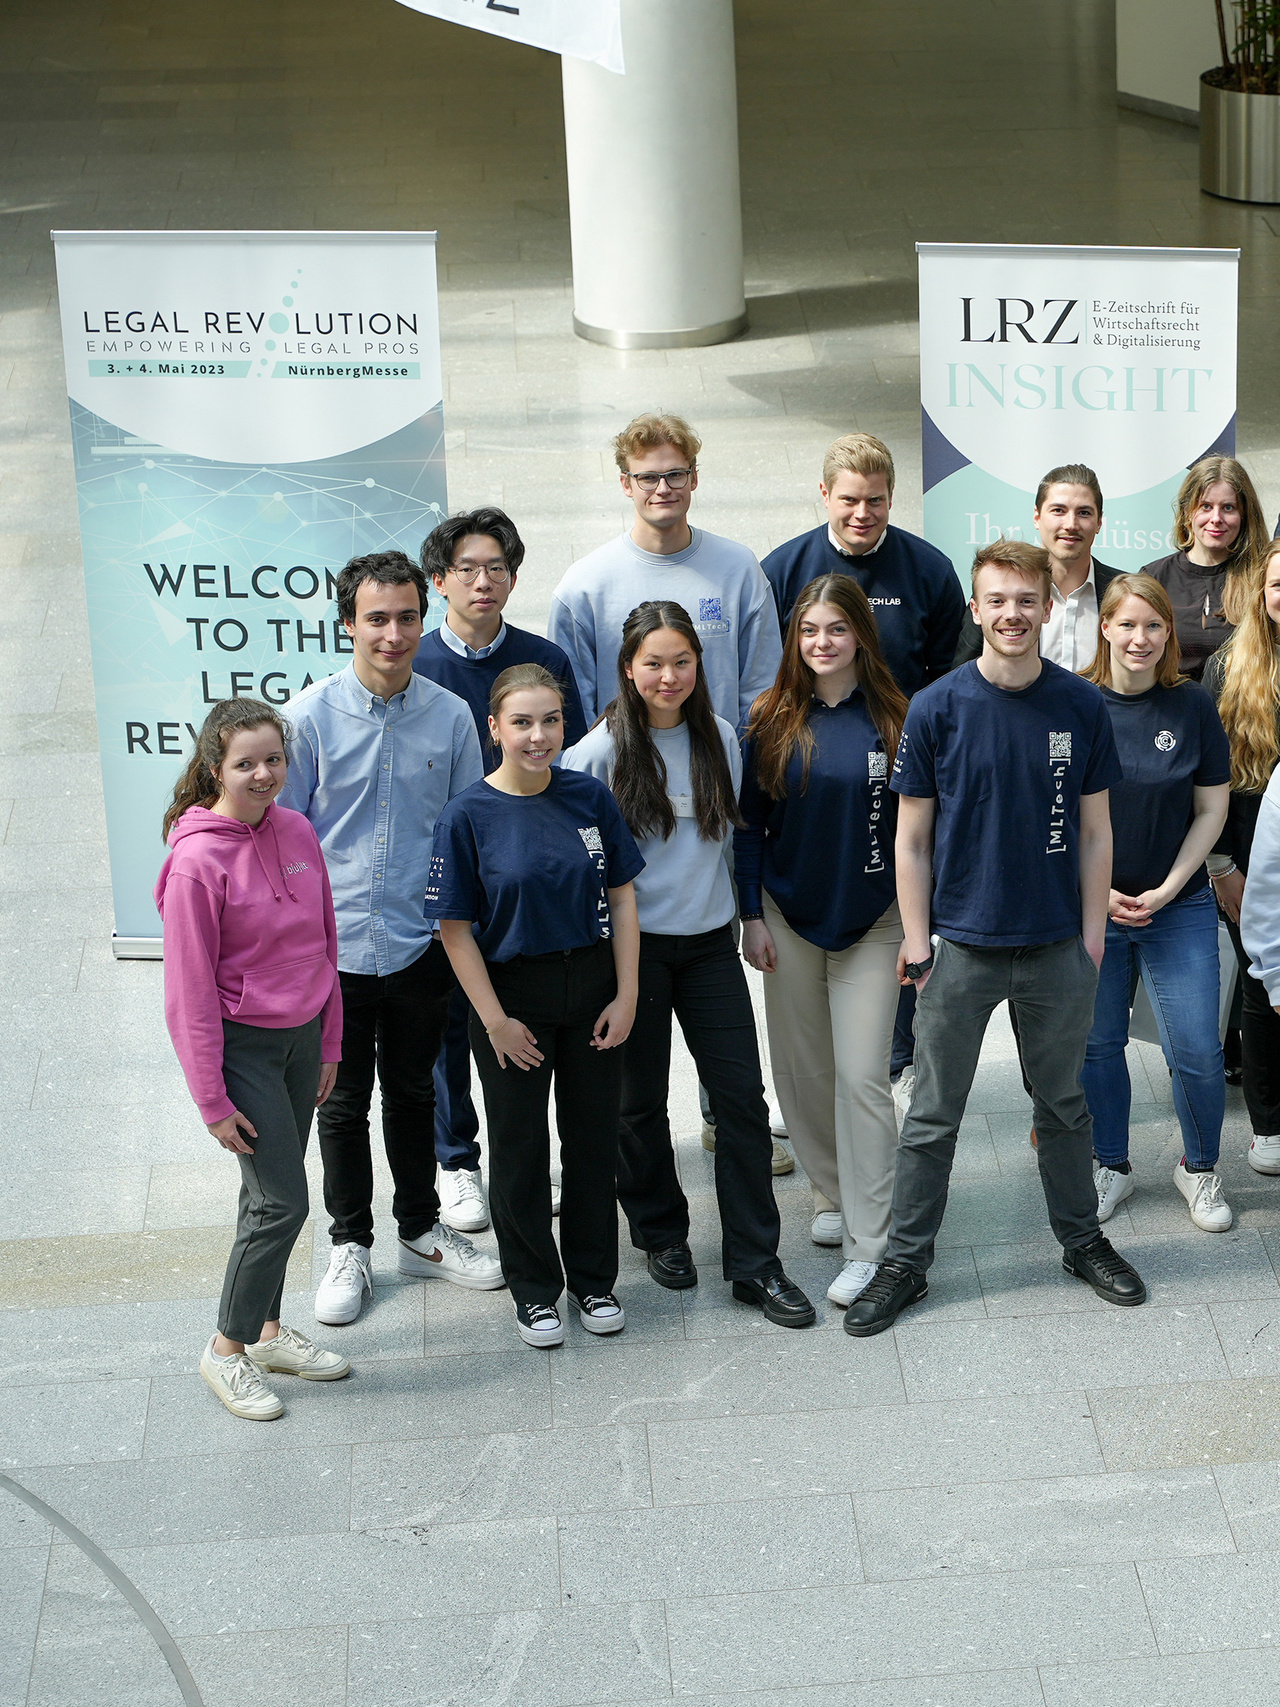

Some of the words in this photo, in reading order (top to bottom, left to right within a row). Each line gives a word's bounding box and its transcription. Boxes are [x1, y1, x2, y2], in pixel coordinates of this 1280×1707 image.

[1093, 300, 1176, 315] E-Zeitschrift
[1180, 301, 1200, 315] für
[84, 310, 189, 334] LEGAL
[960, 297, 1080, 344] LRZ
[1093, 317, 1200, 331] Wirtschaftsrecht
[86, 340, 252, 354] EMPOWERING
[284, 342, 351, 355] LEGAL
[364, 342, 419, 355] PROS
[1093, 333, 1104, 346] &
[1107, 334, 1201, 351] Digitalisierung
[107, 364, 120, 374] 3.
[139, 364, 152, 374] 4.
[158, 364, 185, 374] Mai
[190, 364, 225, 375] 2023
[288, 365, 408, 379] NürnbergMesse
[945, 363, 1213, 413] INSIGHT
[186, 617, 249, 652] TO
[267, 619, 355, 653] THE
